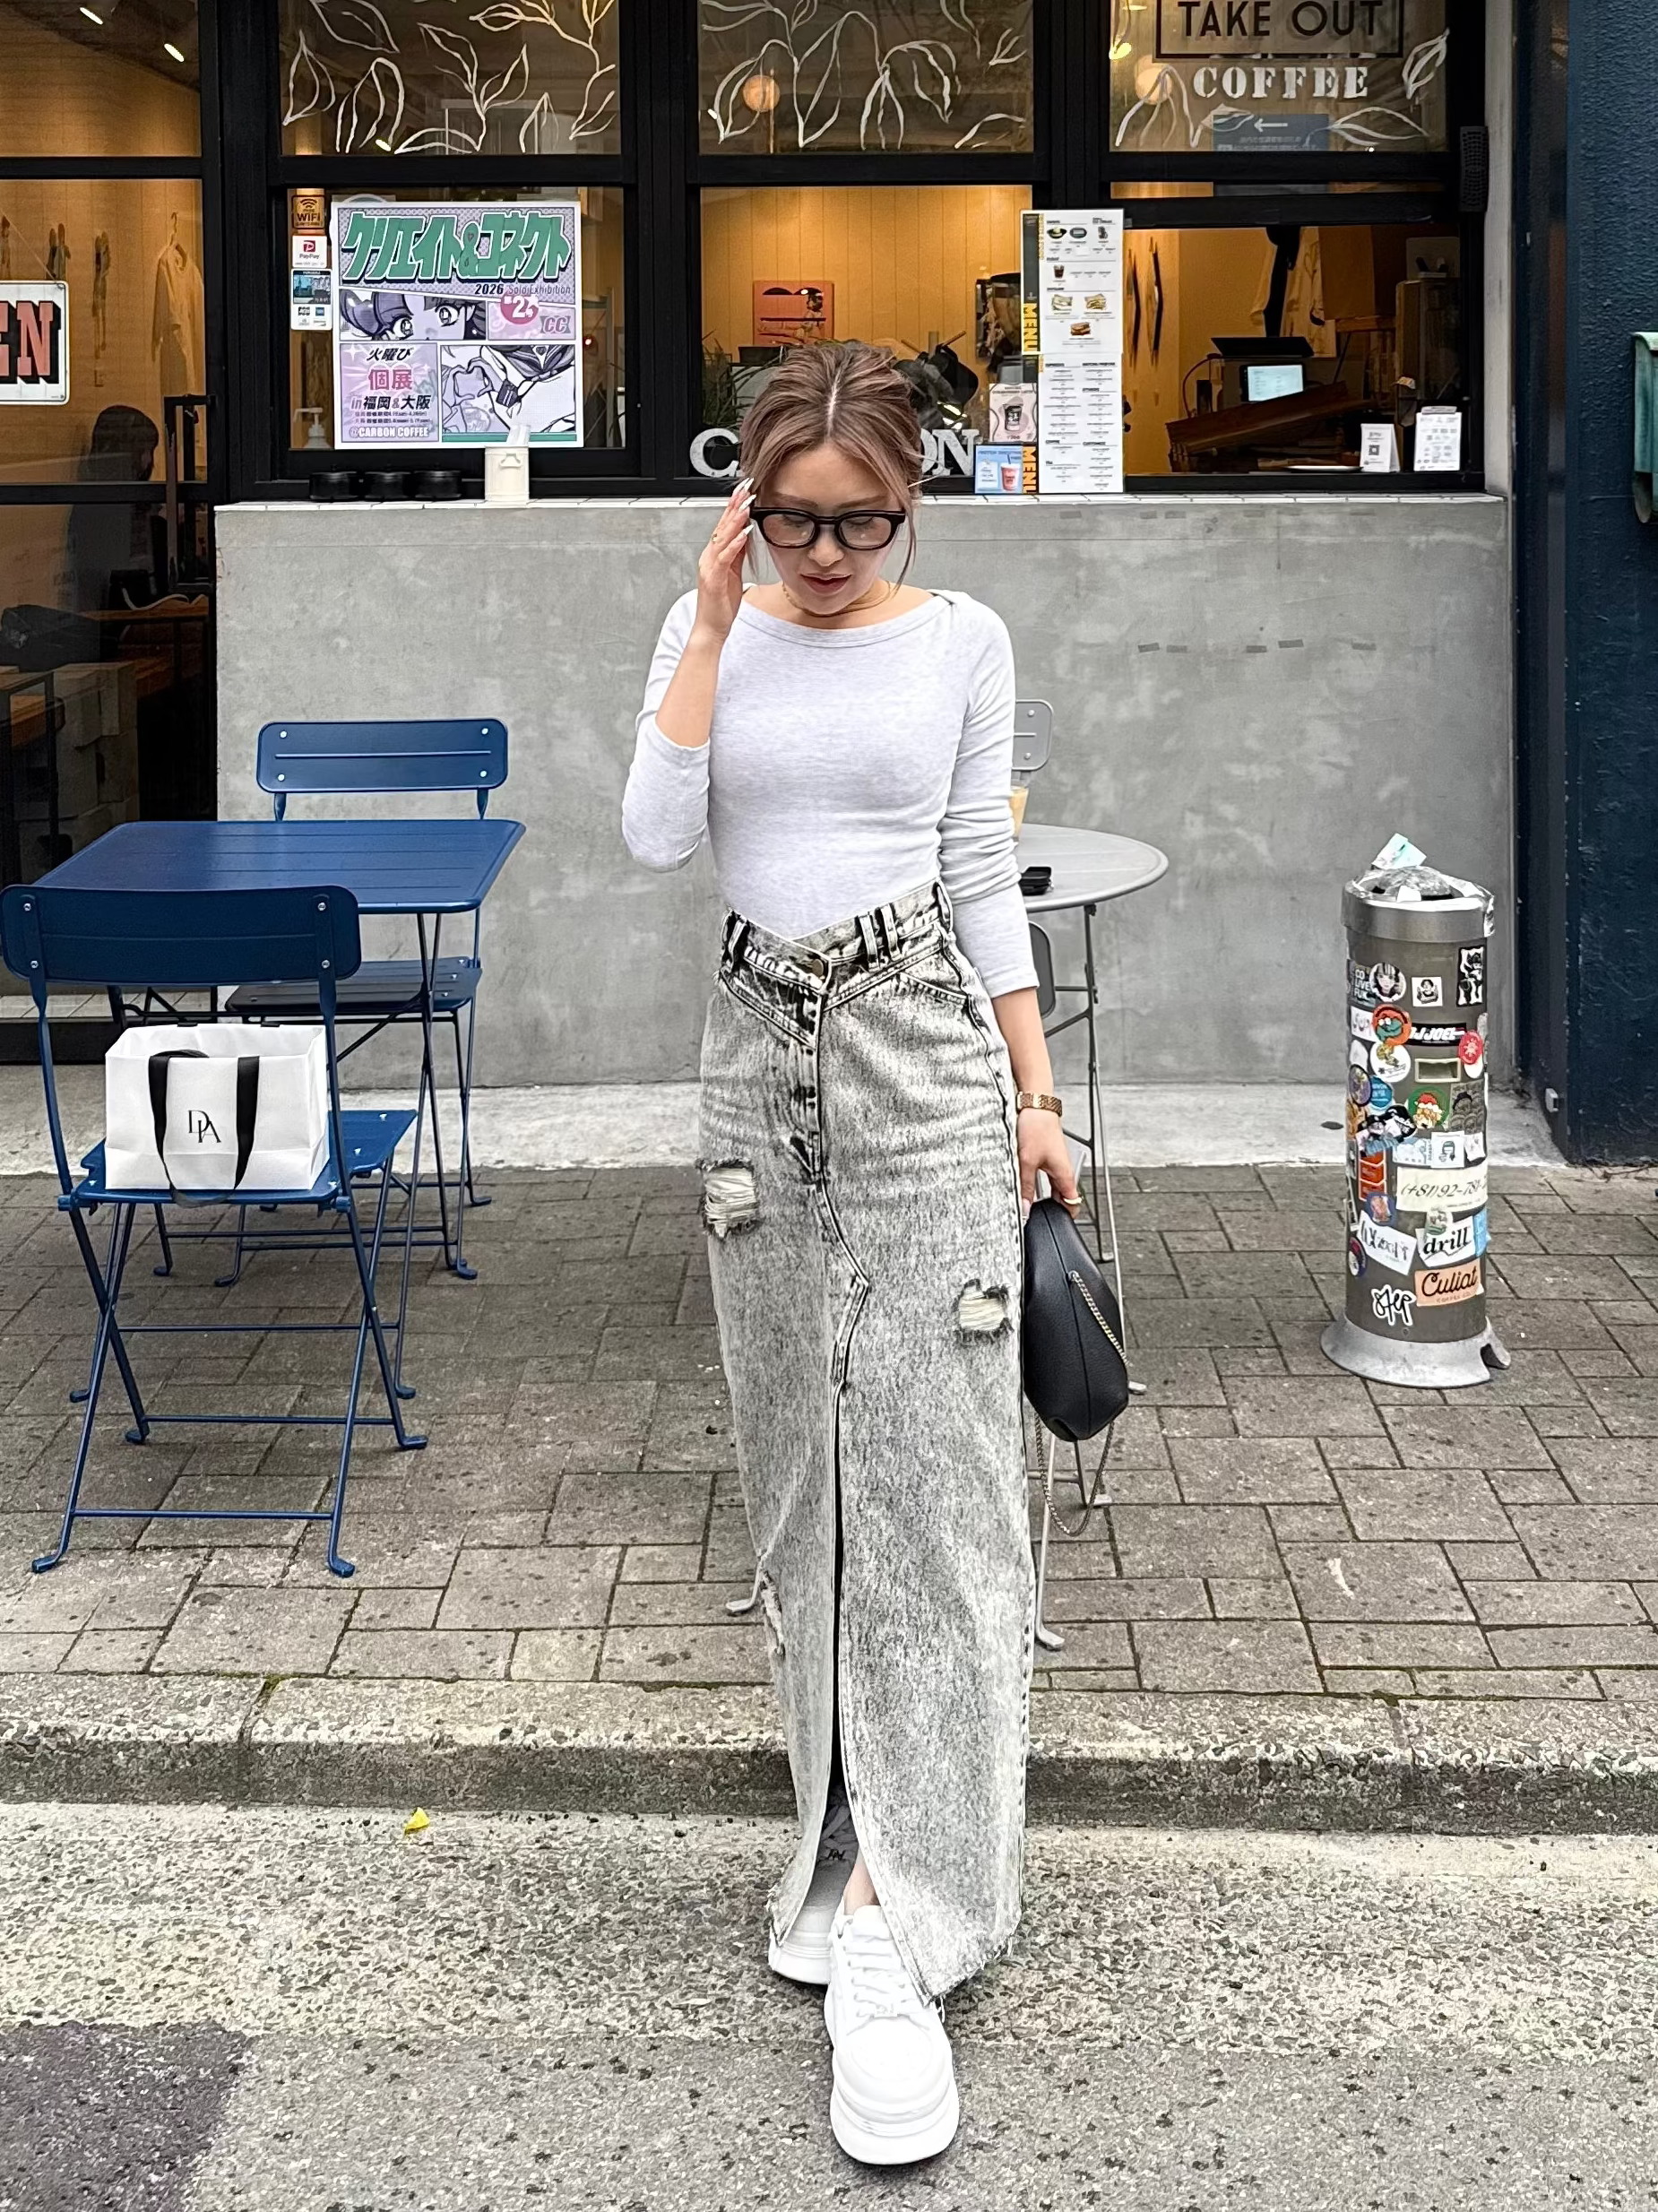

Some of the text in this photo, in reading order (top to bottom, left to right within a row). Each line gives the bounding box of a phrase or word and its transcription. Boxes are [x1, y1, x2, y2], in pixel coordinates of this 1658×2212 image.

[1178, 0, 1383, 37] TAKE OUT
[1193, 66, 1369, 99] COFFEE
[474, 283, 504, 295] 2026
[530, 284, 571, 294] Exhibition
[1023, 303, 1038, 352] MENU
[368, 368, 412, 391] 個展
[397, 428, 429, 438] COFFEE
[1423, 1226, 1470, 1255] drill
